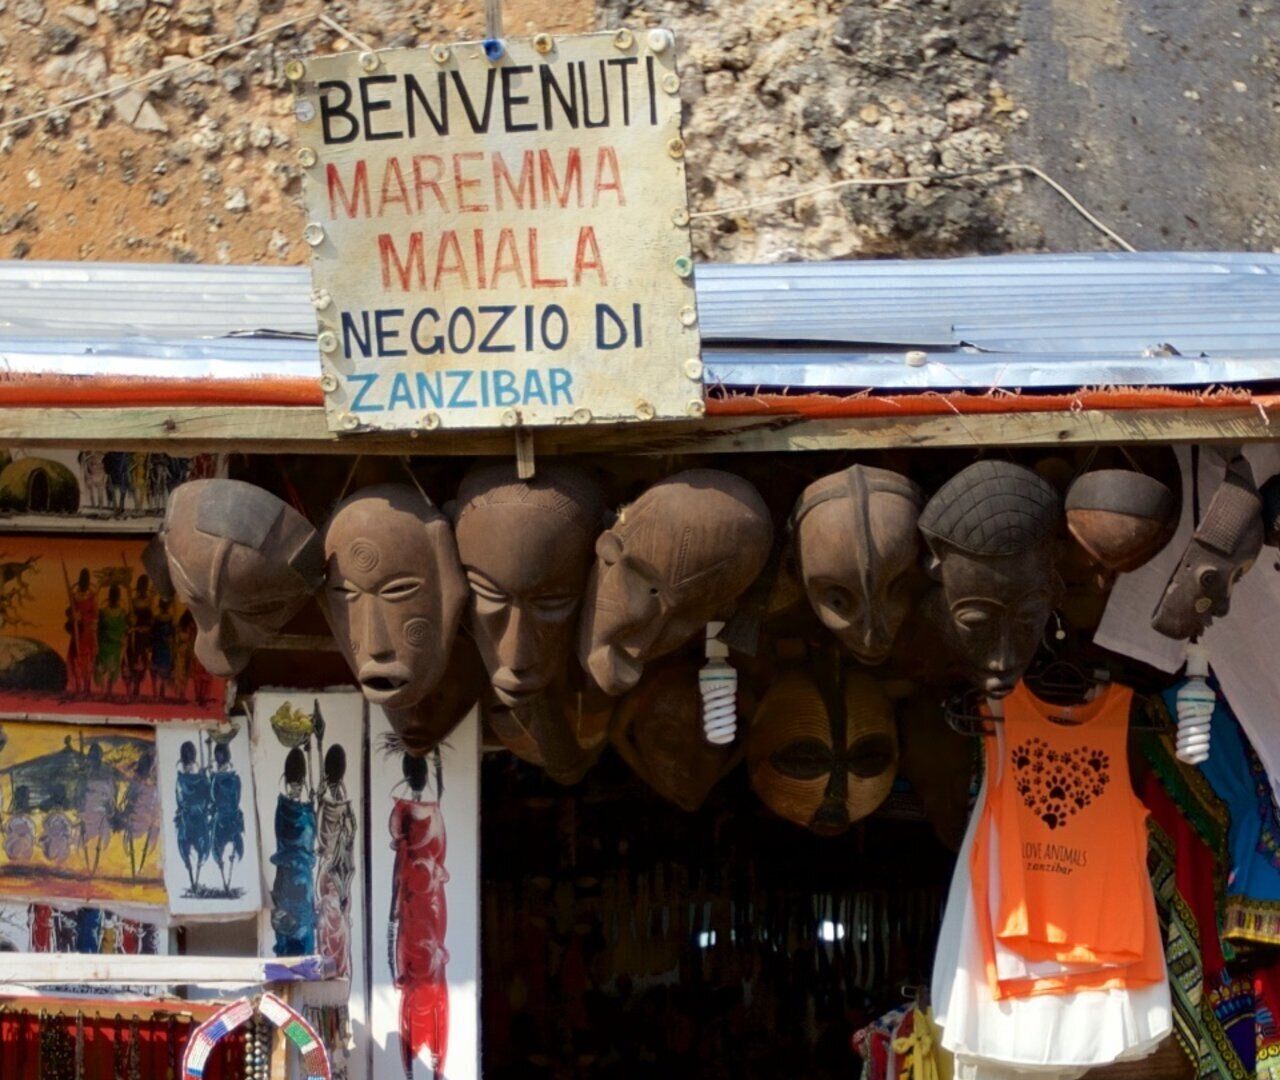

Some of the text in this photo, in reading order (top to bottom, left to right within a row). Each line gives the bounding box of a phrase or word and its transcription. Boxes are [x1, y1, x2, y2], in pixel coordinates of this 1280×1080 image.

[318, 55, 659, 146] BENVENUTI
[325, 145, 627, 220] MAREMMA
[377, 226, 608, 292] MAIALA
[340, 302, 644, 360] NEGOZIO DI
[346, 367, 576, 413] ZANZIBAR
[1021, 842, 1089, 868] LOVE ANIMALS
